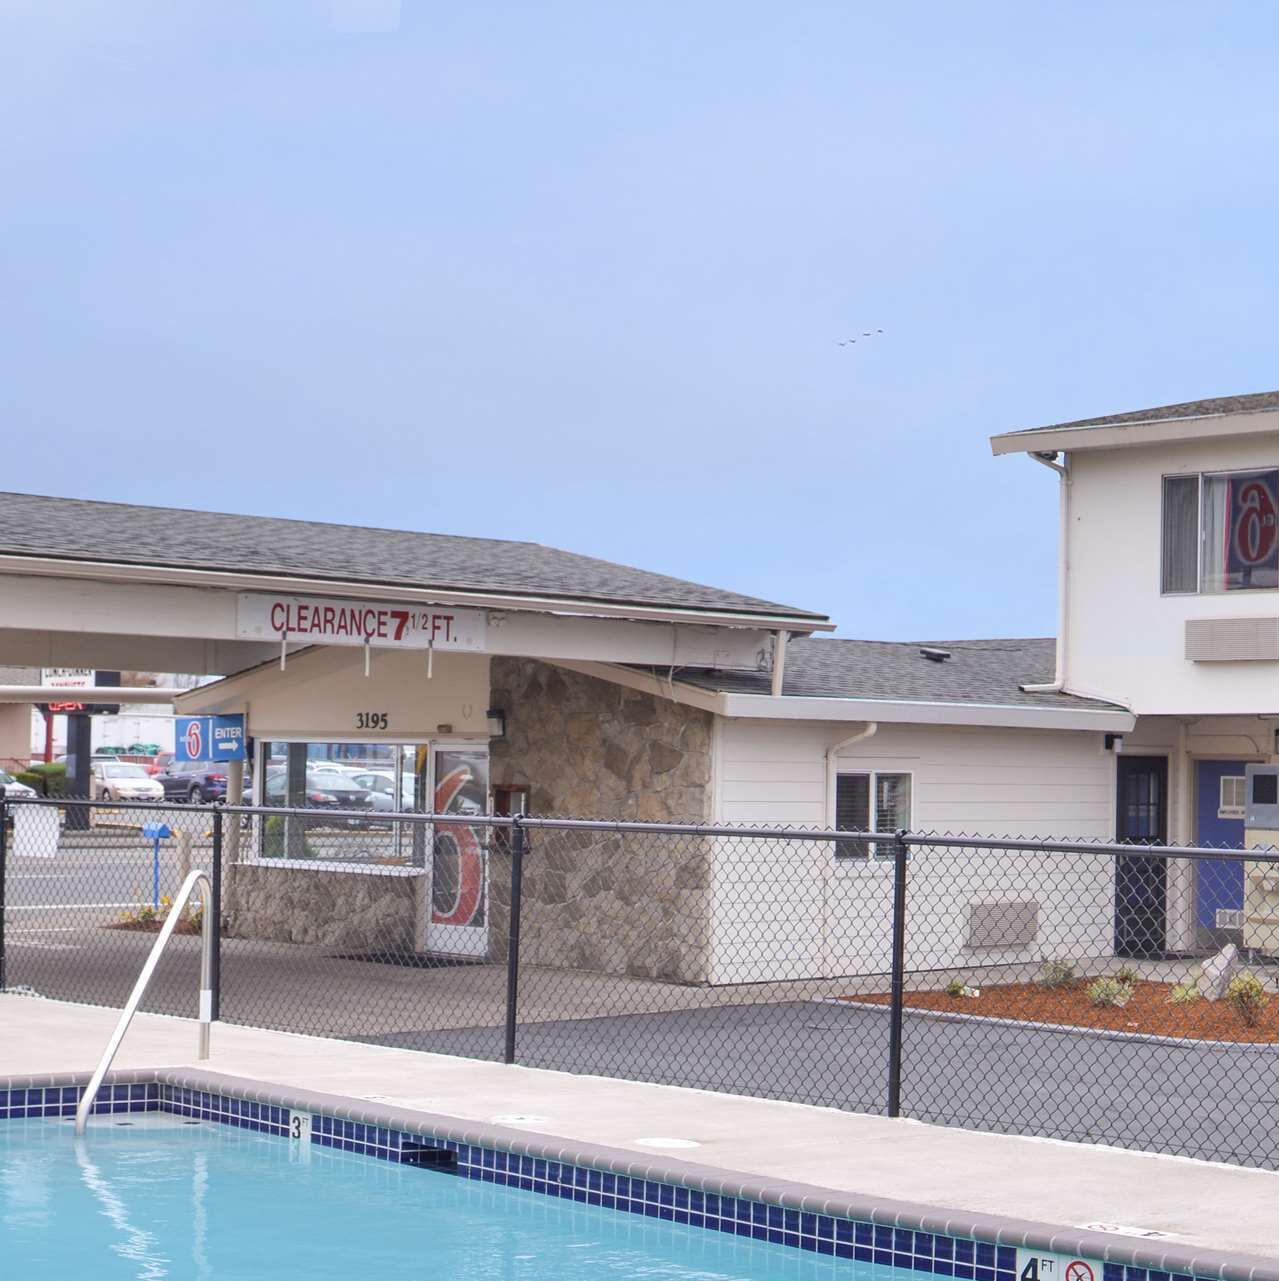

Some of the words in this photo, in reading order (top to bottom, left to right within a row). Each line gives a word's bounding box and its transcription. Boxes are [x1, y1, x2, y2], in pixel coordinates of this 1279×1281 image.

[271, 602, 388, 638] CLEARANCE
[390, 611, 409, 640] 7
[356, 712, 388, 729] 3195
[185, 721, 201, 759] 6
[215, 727, 241, 739] ENTER
[292, 1116, 301, 1139] 3
[1042, 1260, 1055, 1273] FT
